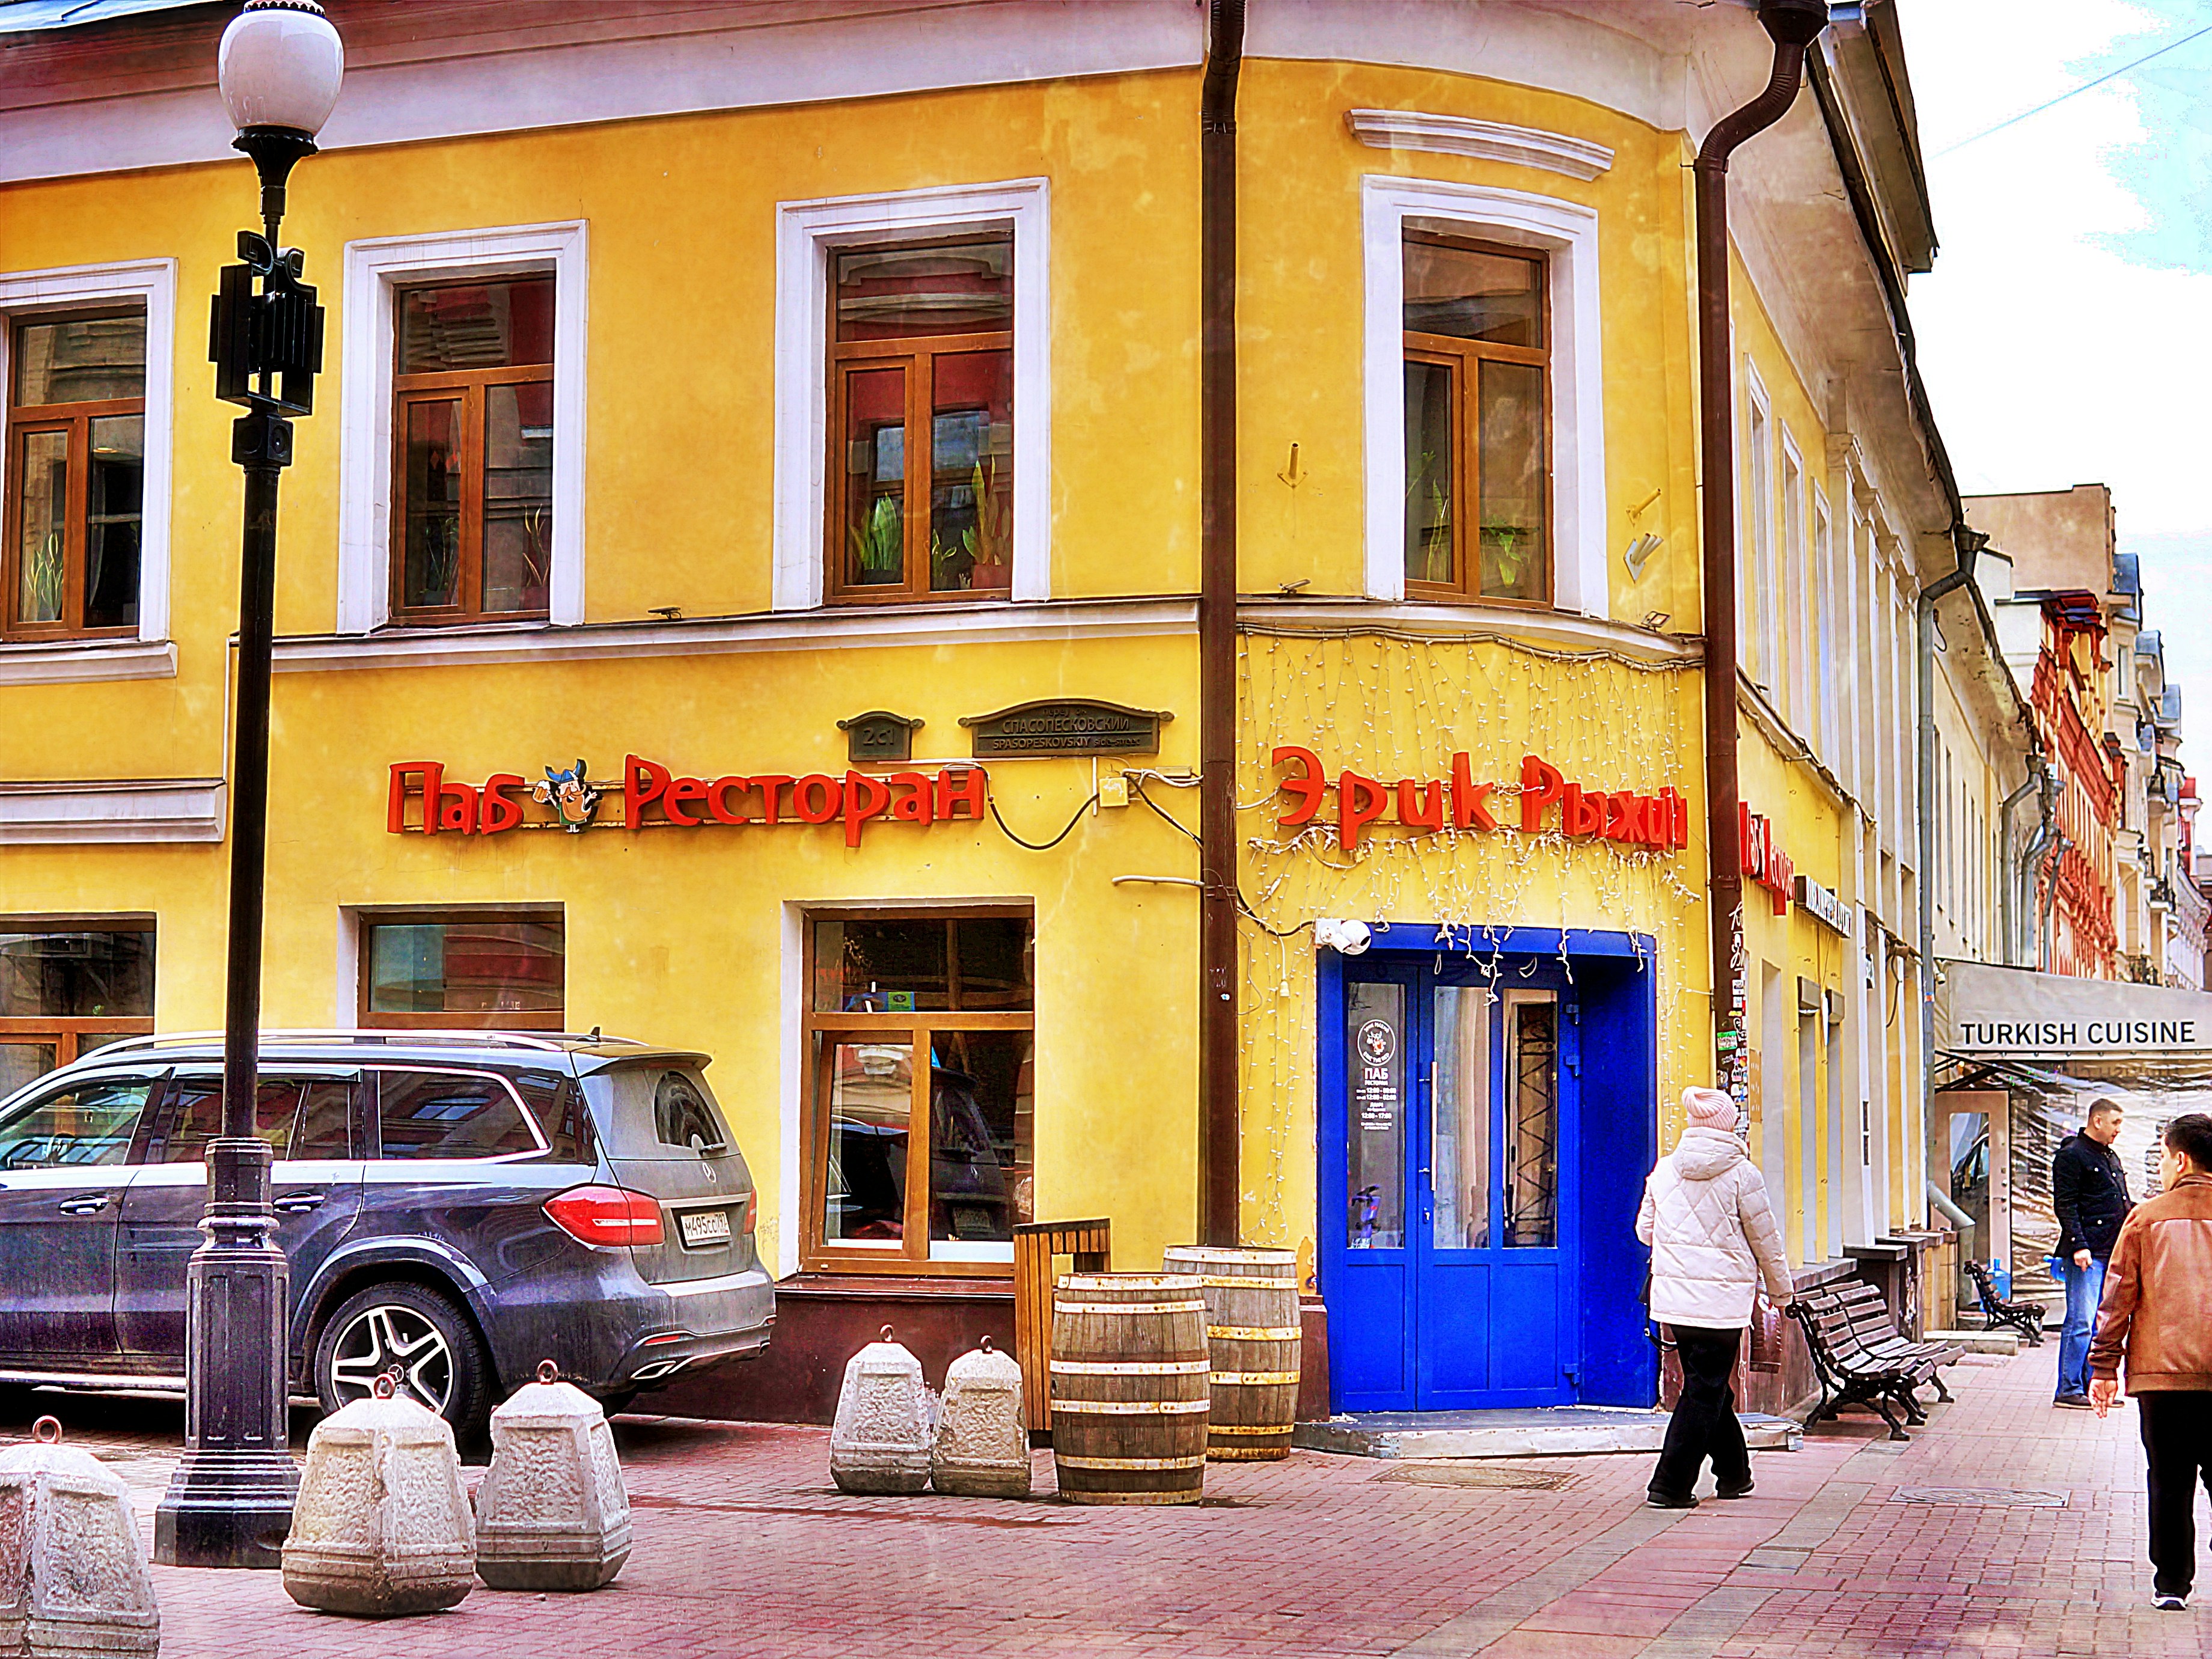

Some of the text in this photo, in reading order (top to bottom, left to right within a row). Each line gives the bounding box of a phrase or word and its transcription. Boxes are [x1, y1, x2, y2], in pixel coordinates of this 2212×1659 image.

[993, 736, 1090, 750] SPASOPESKOVSKIY
[386, 753, 985, 848] Паб Ресторан
[1271, 745, 1688, 851] Эрик Рыжий
[1960, 1021, 2196, 1045] TURKISH CUISINE
[1364, 1068, 1389, 1080] ПАБ
